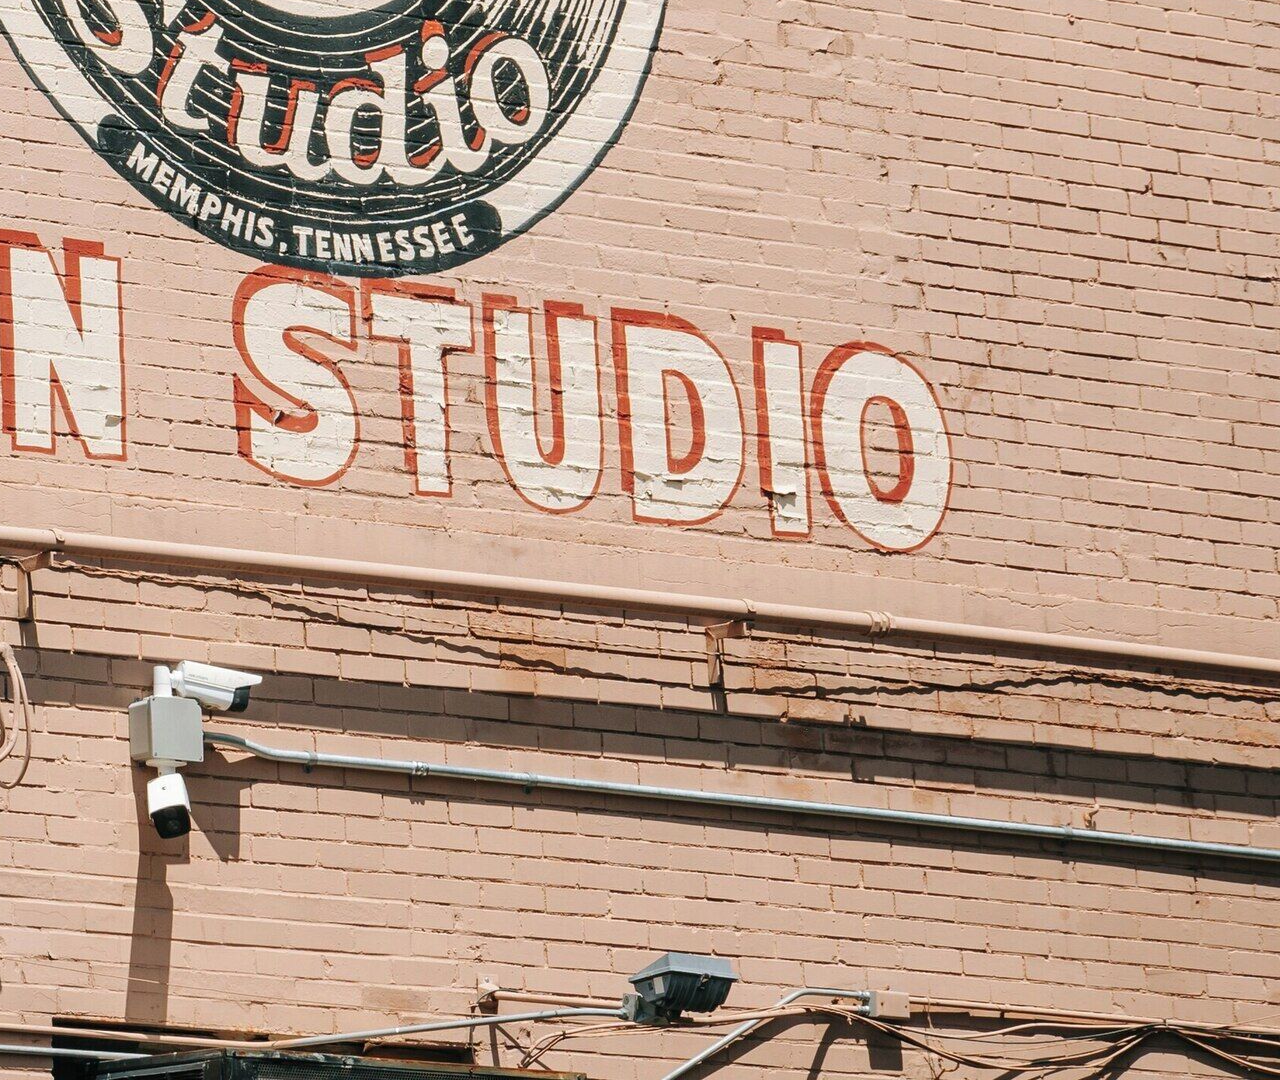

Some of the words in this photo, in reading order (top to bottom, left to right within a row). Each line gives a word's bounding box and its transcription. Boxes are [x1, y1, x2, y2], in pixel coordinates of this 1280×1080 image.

[126, 141, 289, 257] MEMPHIS,
[292, 212, 475, 263] TENNESSEE
[233, 264, 954, 555] STUDIO
